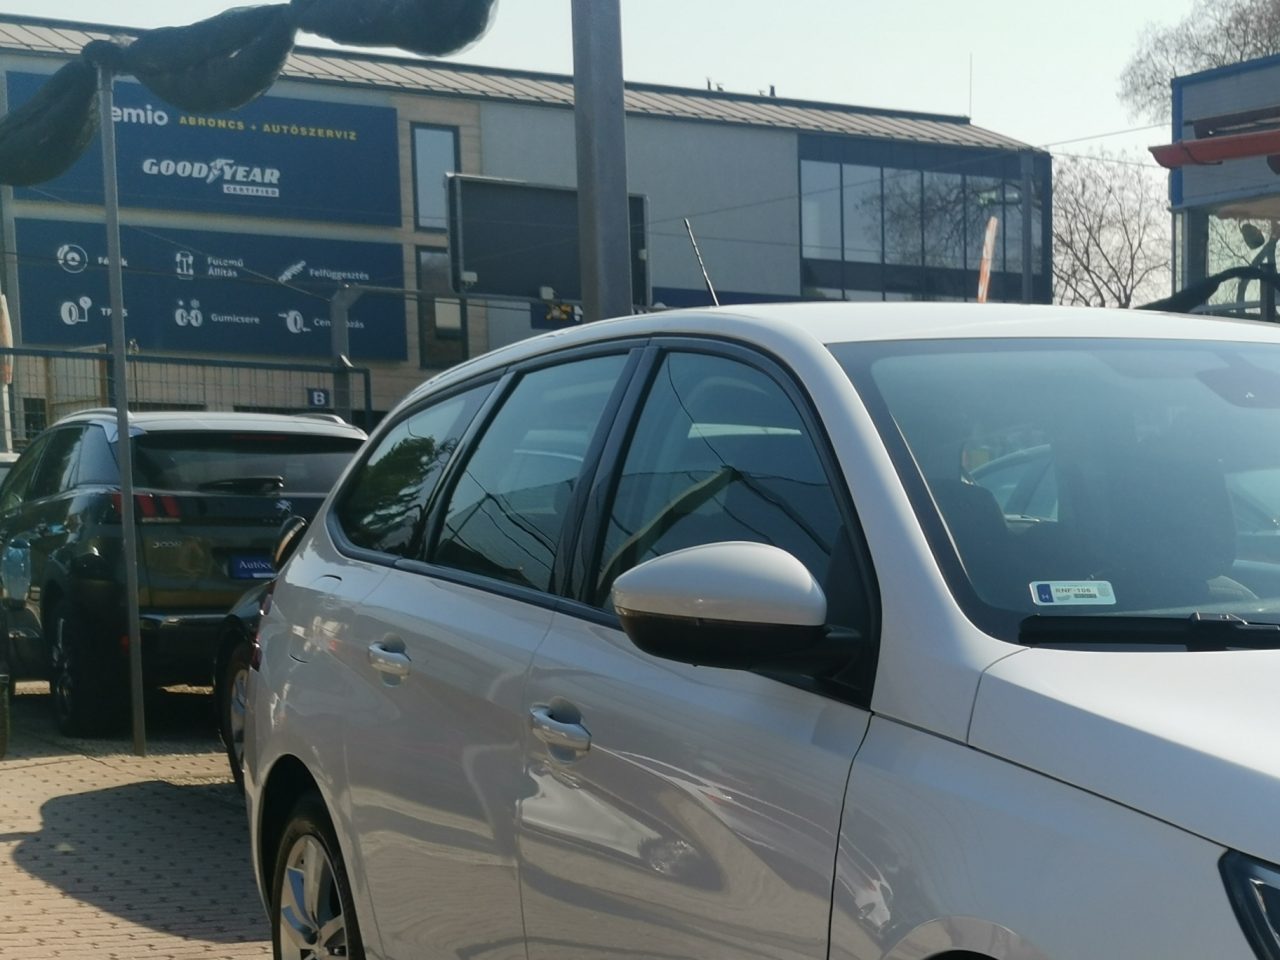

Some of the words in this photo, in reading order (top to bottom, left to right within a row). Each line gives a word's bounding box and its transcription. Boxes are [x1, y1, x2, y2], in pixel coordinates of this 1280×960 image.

[111, 104, 168, 126] emio
[179, 116, 245, 131] ABRONCS
[263, 124, 358, 141] AUTÓSZERVIZ
[142, 158, 280, 184] GOODYEAR
[309, 268, 370, 281] Felfüggesztés
[101, 308, 128, 317] TPS
[211, 313, 260, 324] Gumicsere
[313, 391, 326, 405] B
